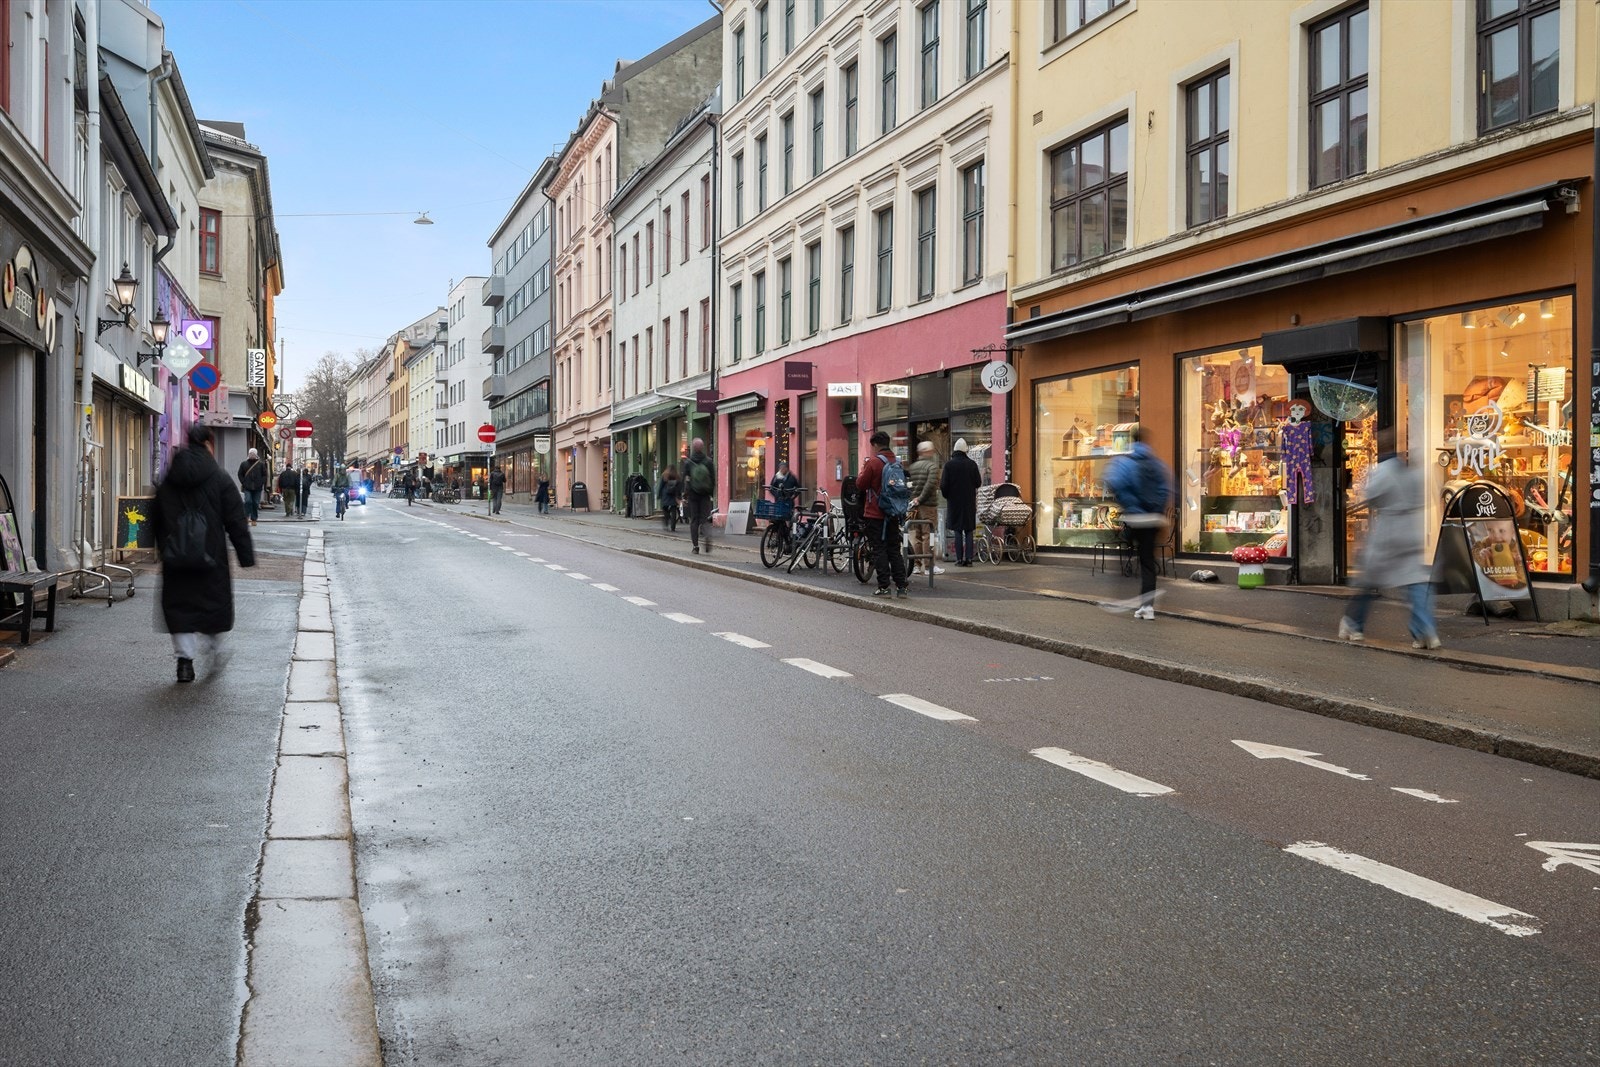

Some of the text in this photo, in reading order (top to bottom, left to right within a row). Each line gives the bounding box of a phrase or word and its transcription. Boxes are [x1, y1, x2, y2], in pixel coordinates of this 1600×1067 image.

[254, 352, 264, 386] GANNI
[988, 375, 1010, 389] SPRELL
[1450, 436, 1507, 477] SPRELL
[1476, 502, 1497, 517] SPRELL
